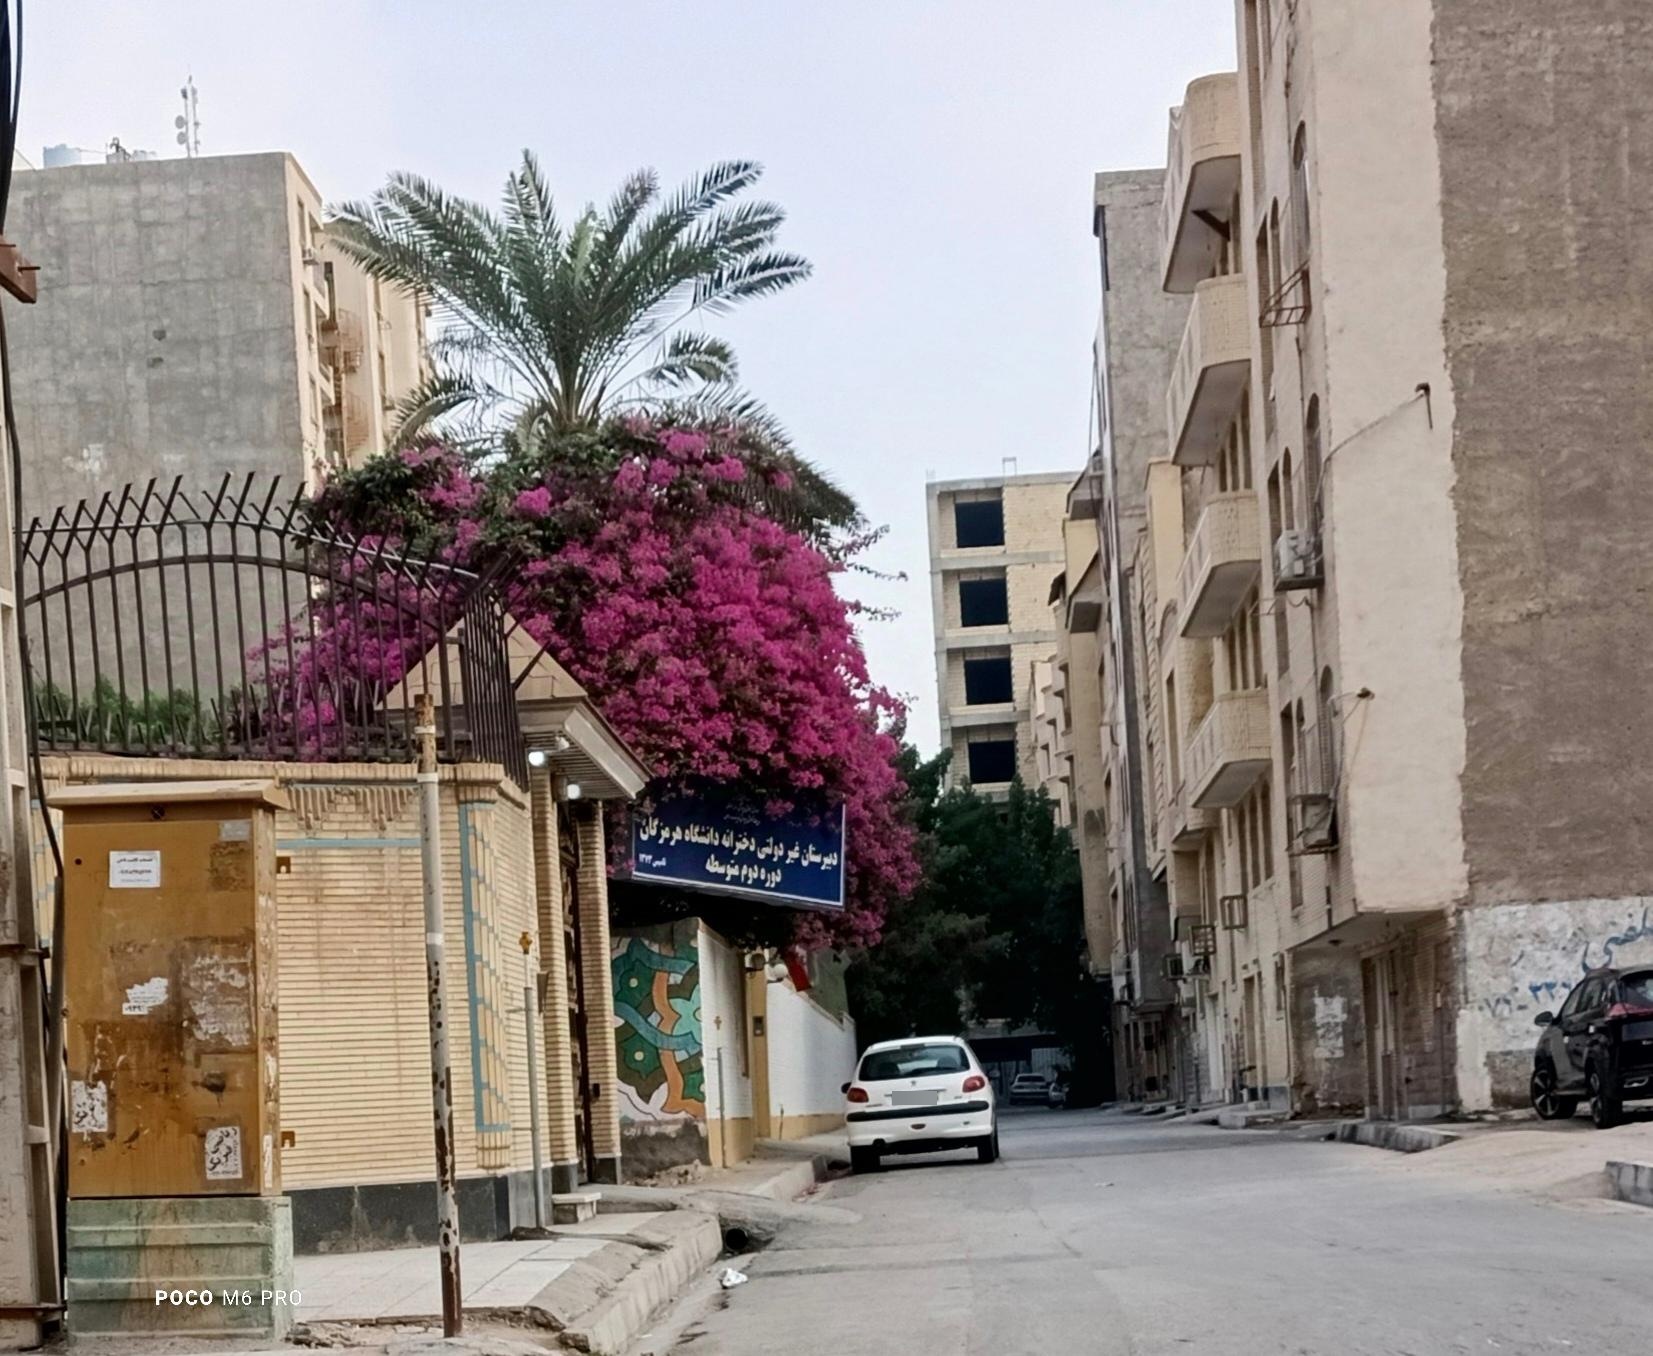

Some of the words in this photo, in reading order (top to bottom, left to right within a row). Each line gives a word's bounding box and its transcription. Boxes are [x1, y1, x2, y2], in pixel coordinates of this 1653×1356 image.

[639, 816, 682, 846] هرمزگان
[684, 823, 719, 846] دانشگاه
[721, 829, 755, 855] دخترانه
[757, 836, 784, 862] دولتی
[785, 841, 800, 864] غیر
[801, 843, 838, 870] دبیرستان
[705, 853, 739, 881] متوسطه
[741, 864, 758, 884] دوم
[760, 867, 781, 888] دوره
